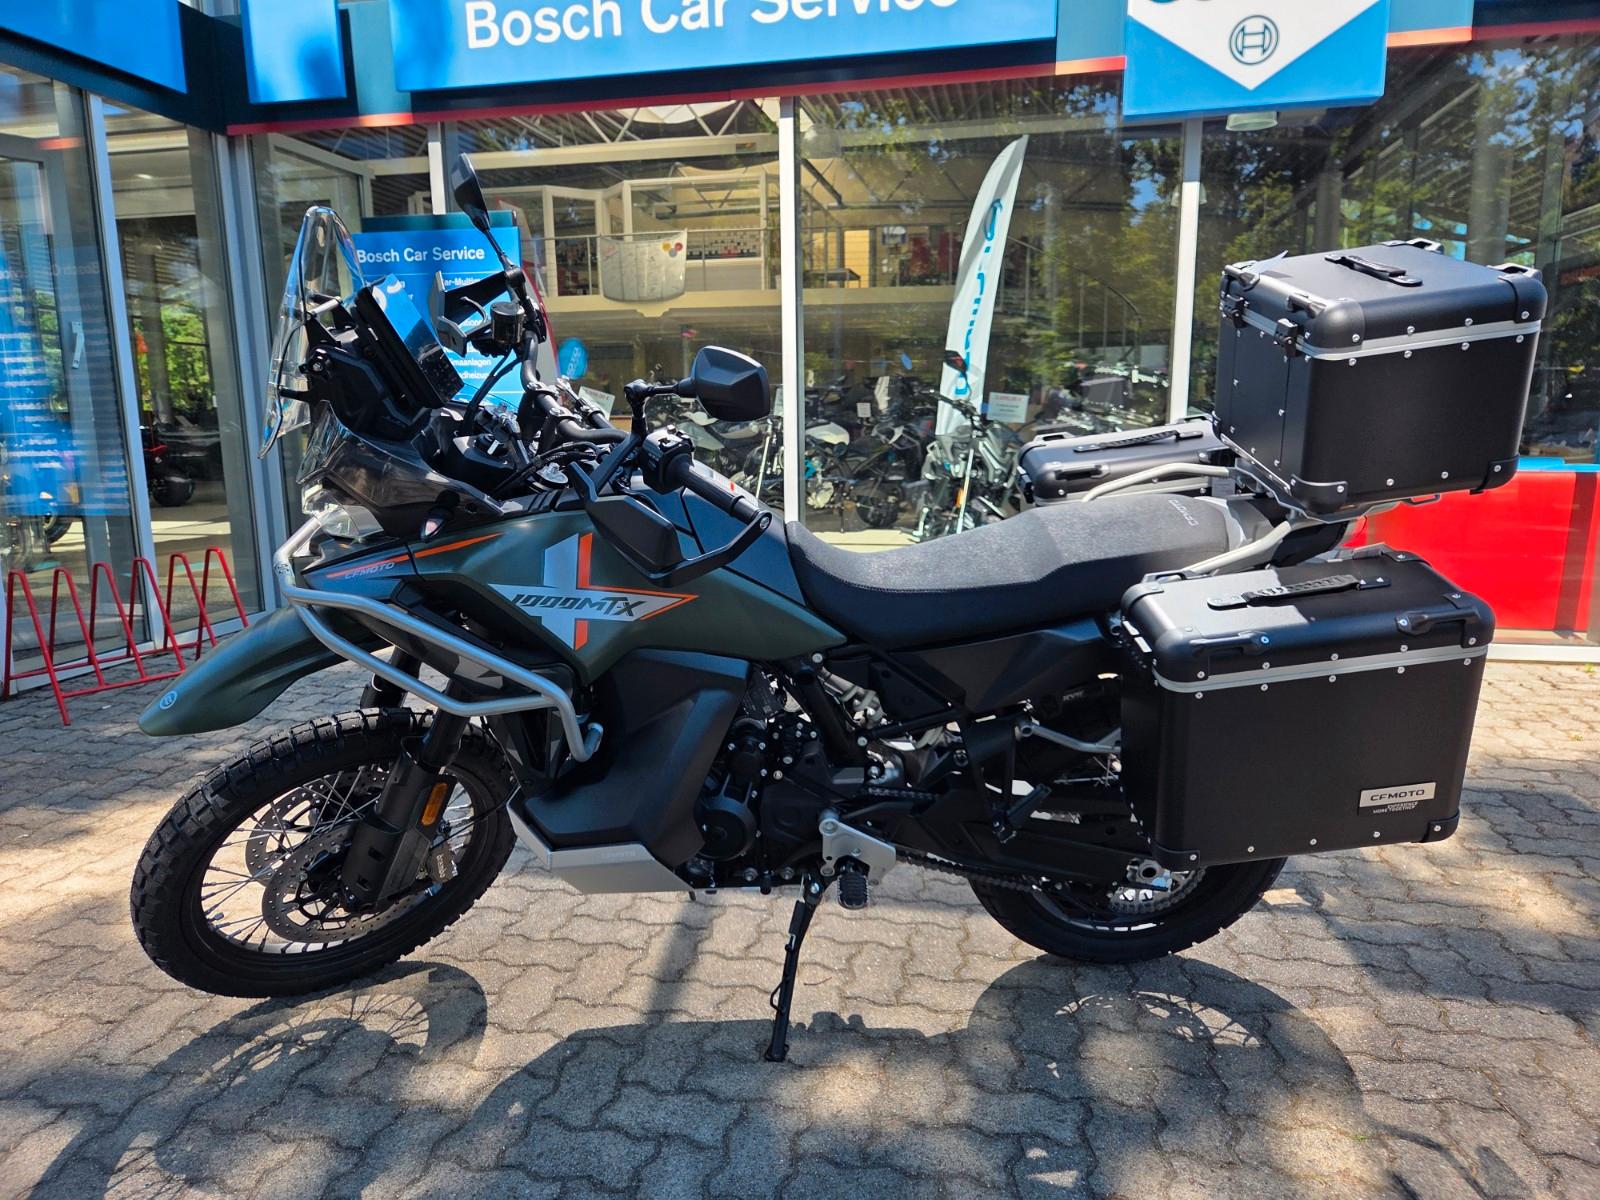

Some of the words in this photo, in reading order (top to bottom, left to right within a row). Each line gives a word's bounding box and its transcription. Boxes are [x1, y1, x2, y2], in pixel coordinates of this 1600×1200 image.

[465, 0, 622, 49] Bosch
[357, 249, 399, 263] Bosch
[403, 248, 427, 262] Car
[432, 246, 485, 260] Service
[1370, 789, 1424, 801] CFMOTO
